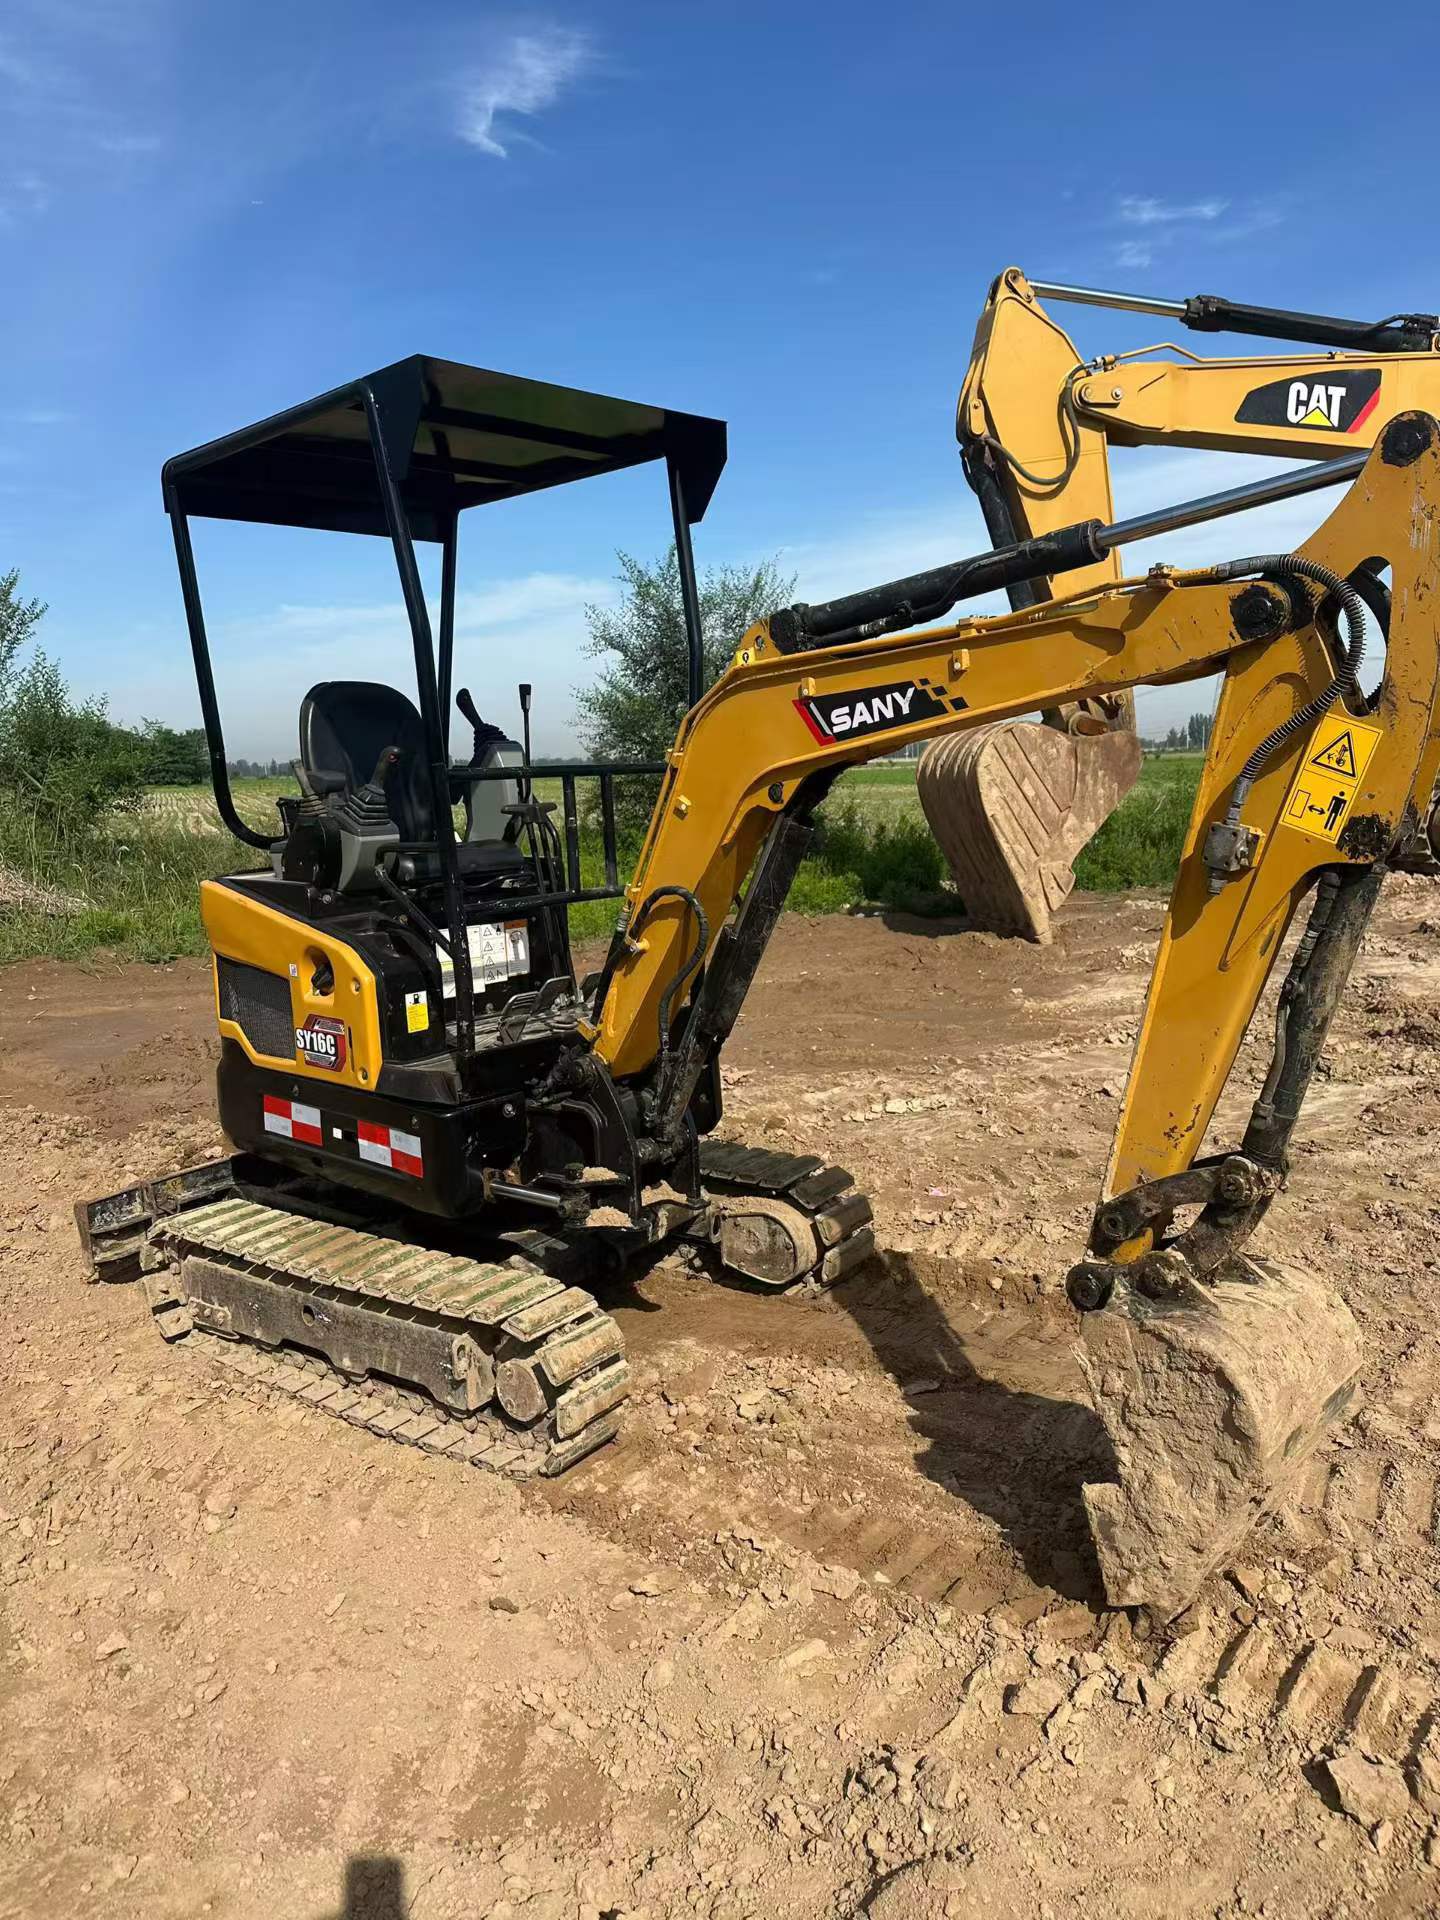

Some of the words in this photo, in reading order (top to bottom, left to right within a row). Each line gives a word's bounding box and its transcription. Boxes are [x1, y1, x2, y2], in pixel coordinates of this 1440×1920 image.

[1286, 381, 1347, 428] CAT
[830, 686, 916, 734] SANY
[296, 1028, 336, 1055] SY16C
